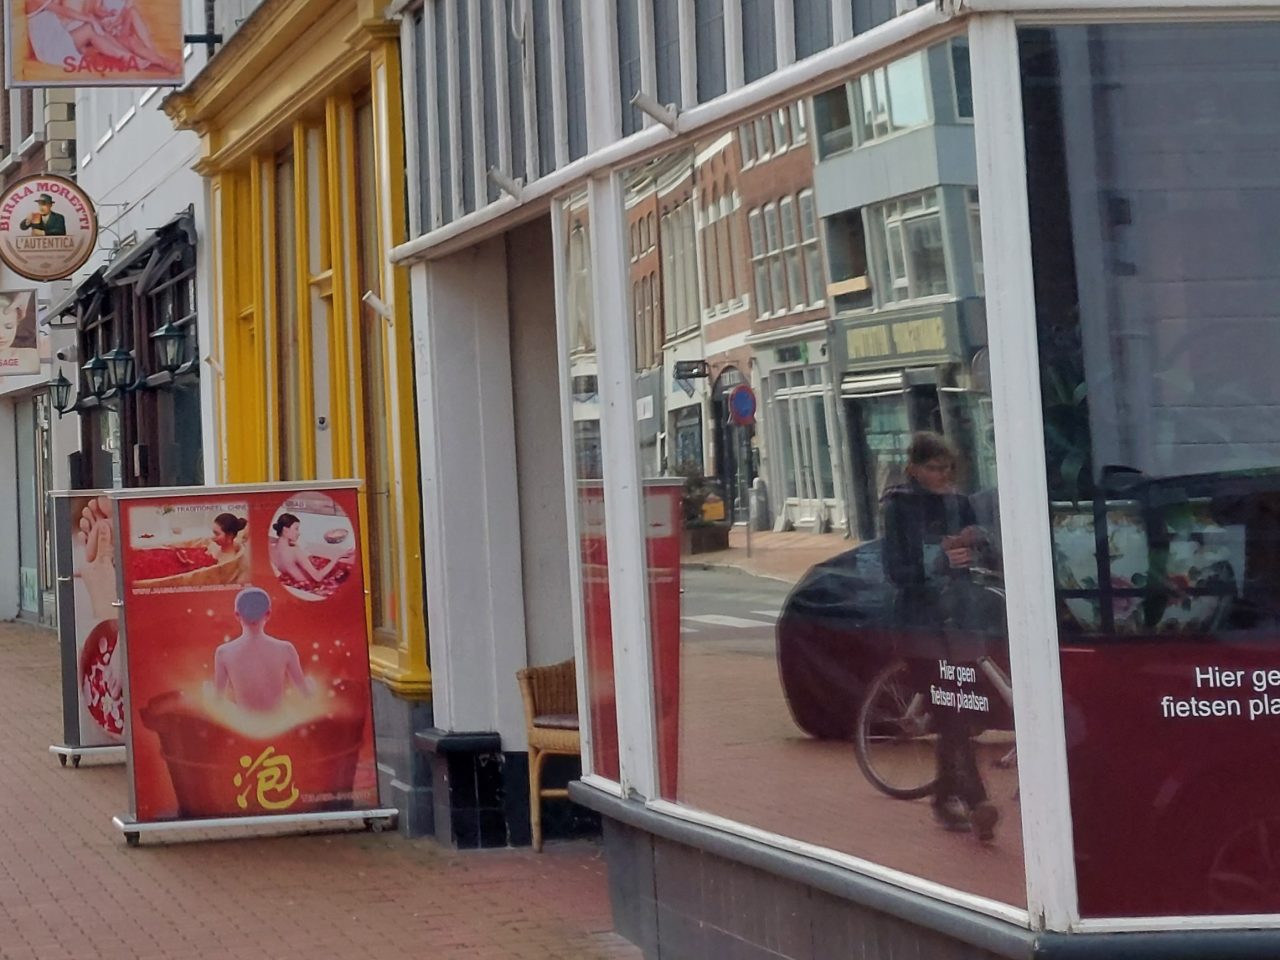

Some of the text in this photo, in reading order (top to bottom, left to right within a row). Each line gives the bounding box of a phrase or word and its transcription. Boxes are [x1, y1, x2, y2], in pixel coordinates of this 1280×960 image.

[0, 181, 91, 232] BIRRA MORETTI
[15, 236, 75, 250] L'AUTENTICA
[939, 659, 976, 687] Hier geen
[1195, 666, 1245, 688] Hier
[930, 684, 990, 713] fietsen plaatsen
[1161, 696, 1241, 717] fietsen
